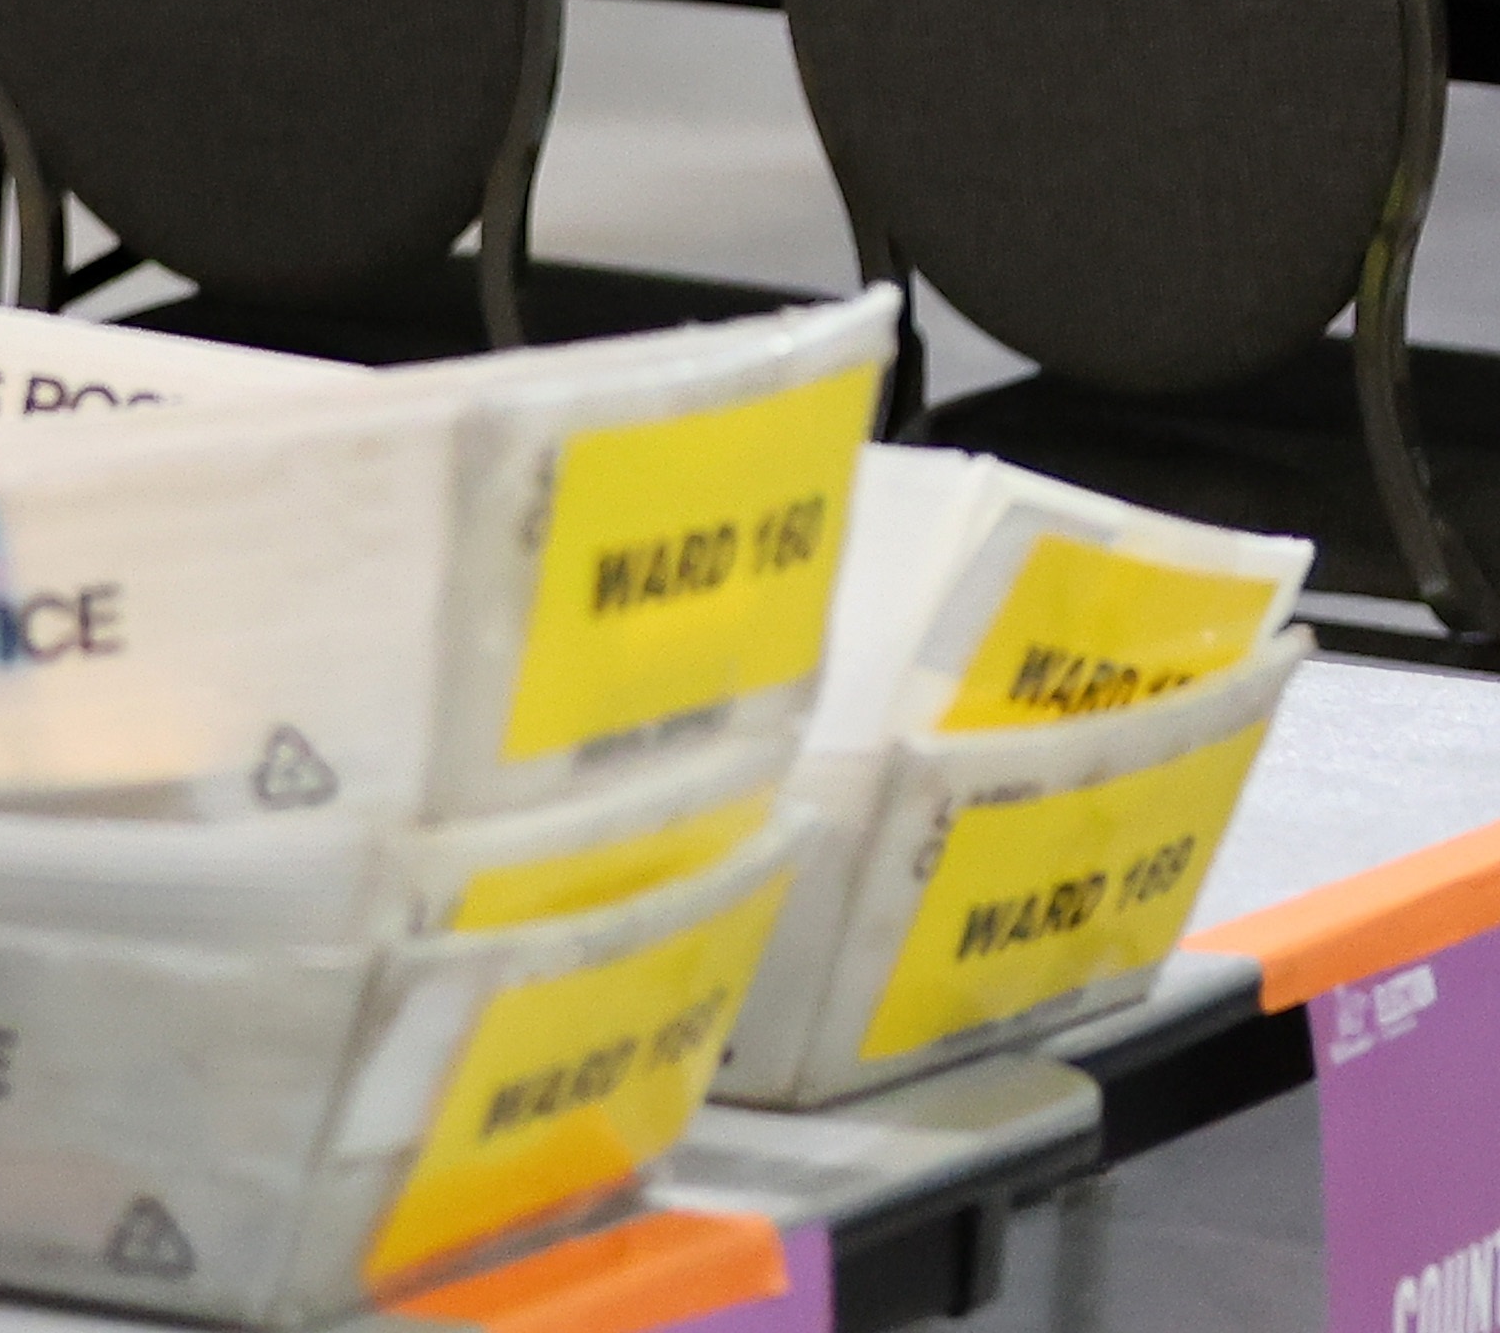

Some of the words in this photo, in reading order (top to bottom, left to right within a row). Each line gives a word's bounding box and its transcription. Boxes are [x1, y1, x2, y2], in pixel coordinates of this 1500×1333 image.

[593, 522, 738, 616] WARD
[956, 870, 1107, 963] WARD
[1391, 1226, 1500, 1333] COUN
